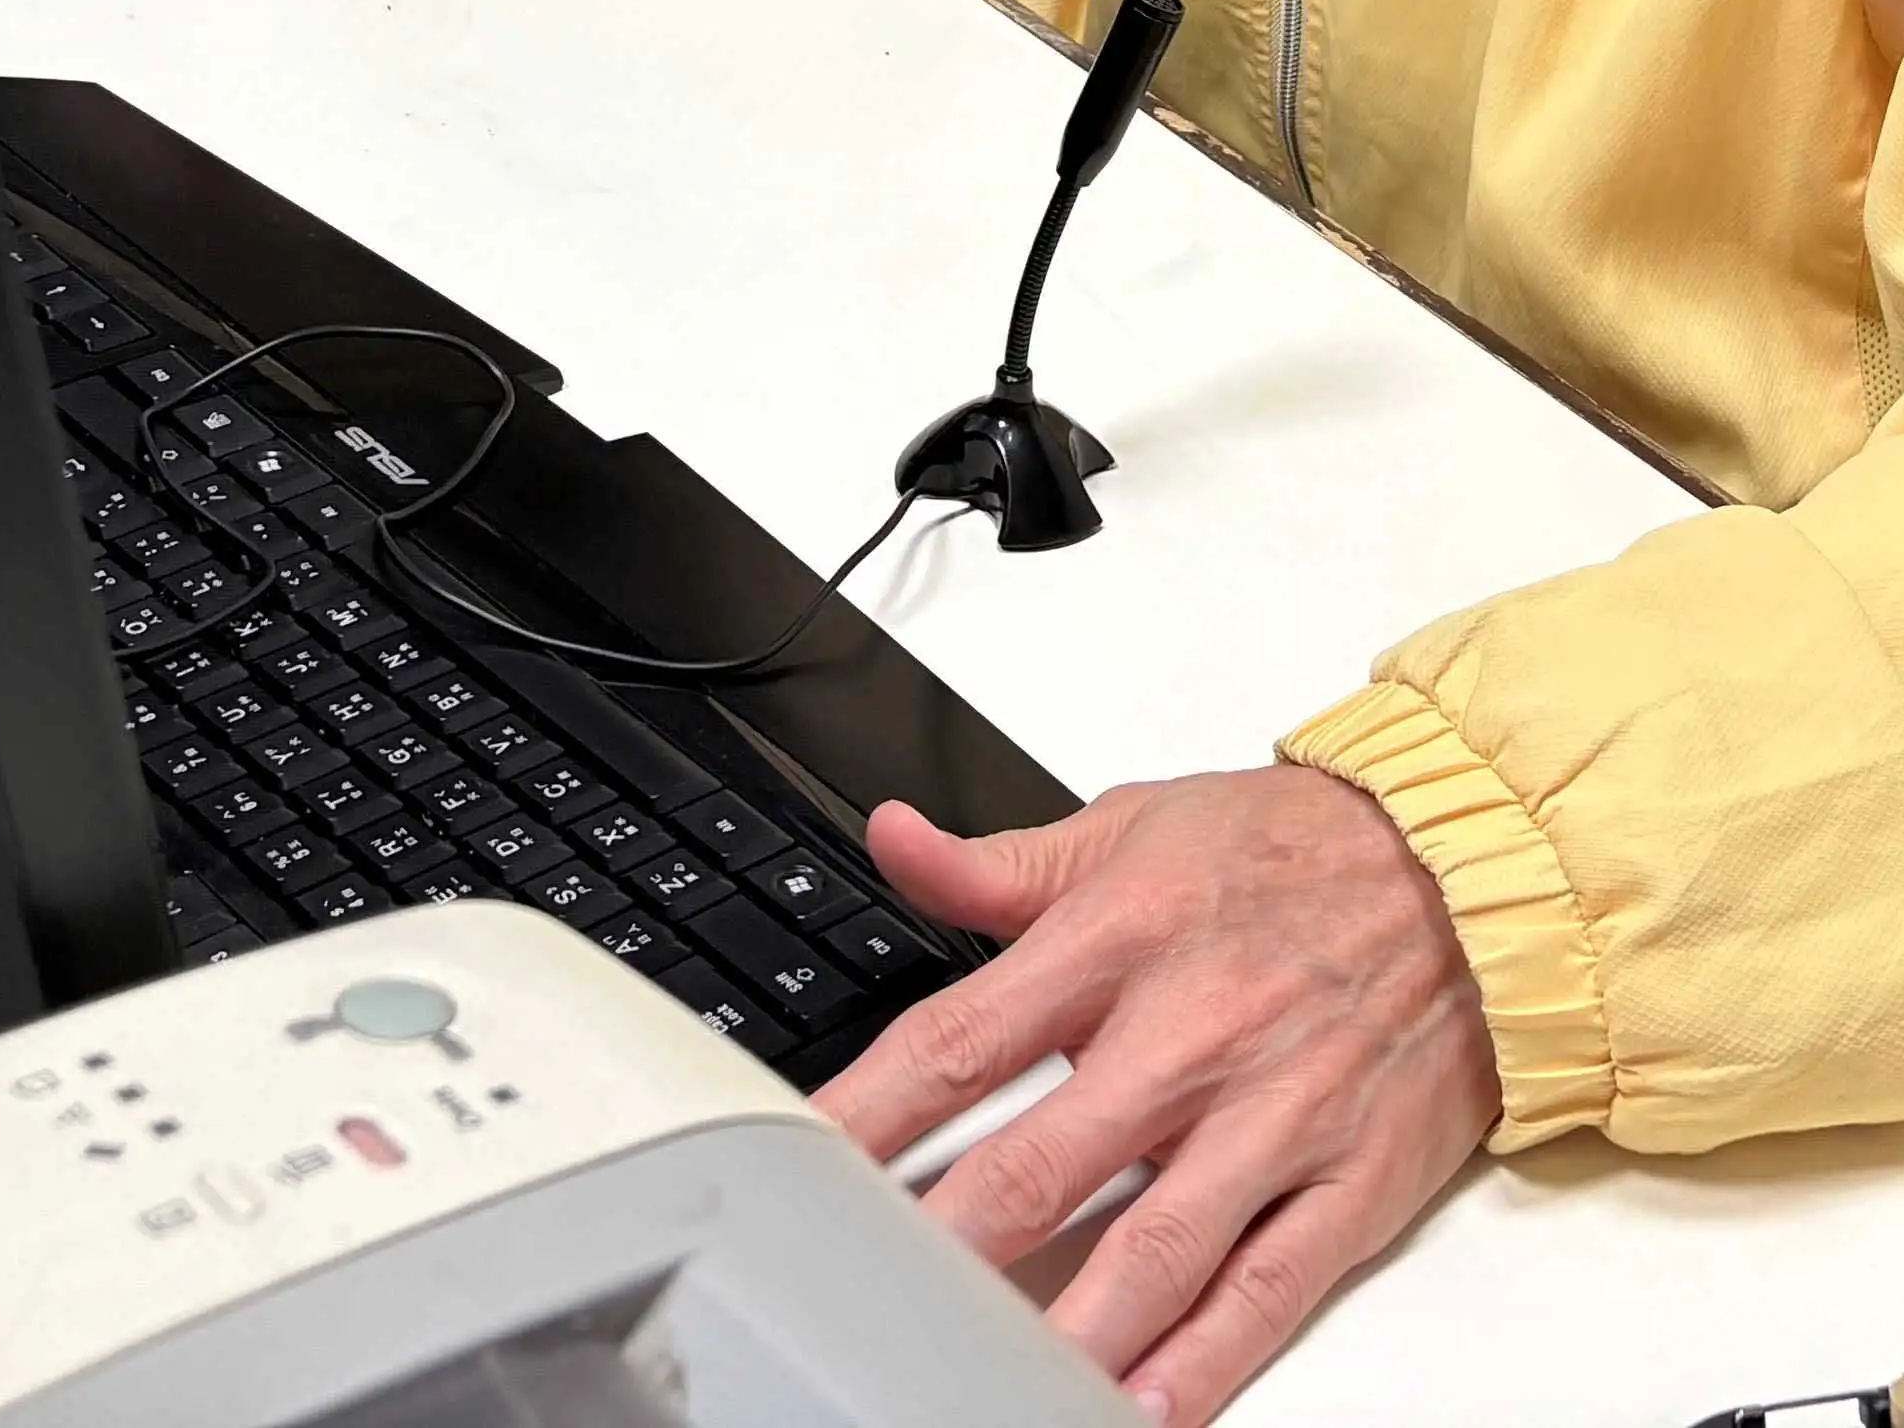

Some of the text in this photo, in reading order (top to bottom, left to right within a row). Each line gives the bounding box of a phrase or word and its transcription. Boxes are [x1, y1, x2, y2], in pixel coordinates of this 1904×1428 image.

[334, 426, 429, 486] ASUS
[124, 620, 148, 635] O
[330, 611, 359, 628] M
[234, 621, 259, 639] K
[284, 663, 308, 676] J
[384, 653, 408, 670] N
[436, 695, 461, 711] B
[221, 707, 246, 723] U
[333, 705, 360, 722] H
[487, 740, 510, 756] V
[270, 751, 295, 766] Y
[387, 748, 411, 765] G
[542, 783, 567, 800] C
[239, 798, 258, 813] 6
[323, 796, 347, 811] T
[440, 798, 466, 812] F
[598, 828, 625, 846] X
[291, 847, 311, 861] 5
[377, 840, 404, 857] R
[495, 841, 521, 857] D
[658, 877, 686, 894] Z
[432, 889, 458, 905] E
[553, 889, 578, 905] S
[614, 938, 640, 956] A
[716, 1003, 745, 1027] Lock
